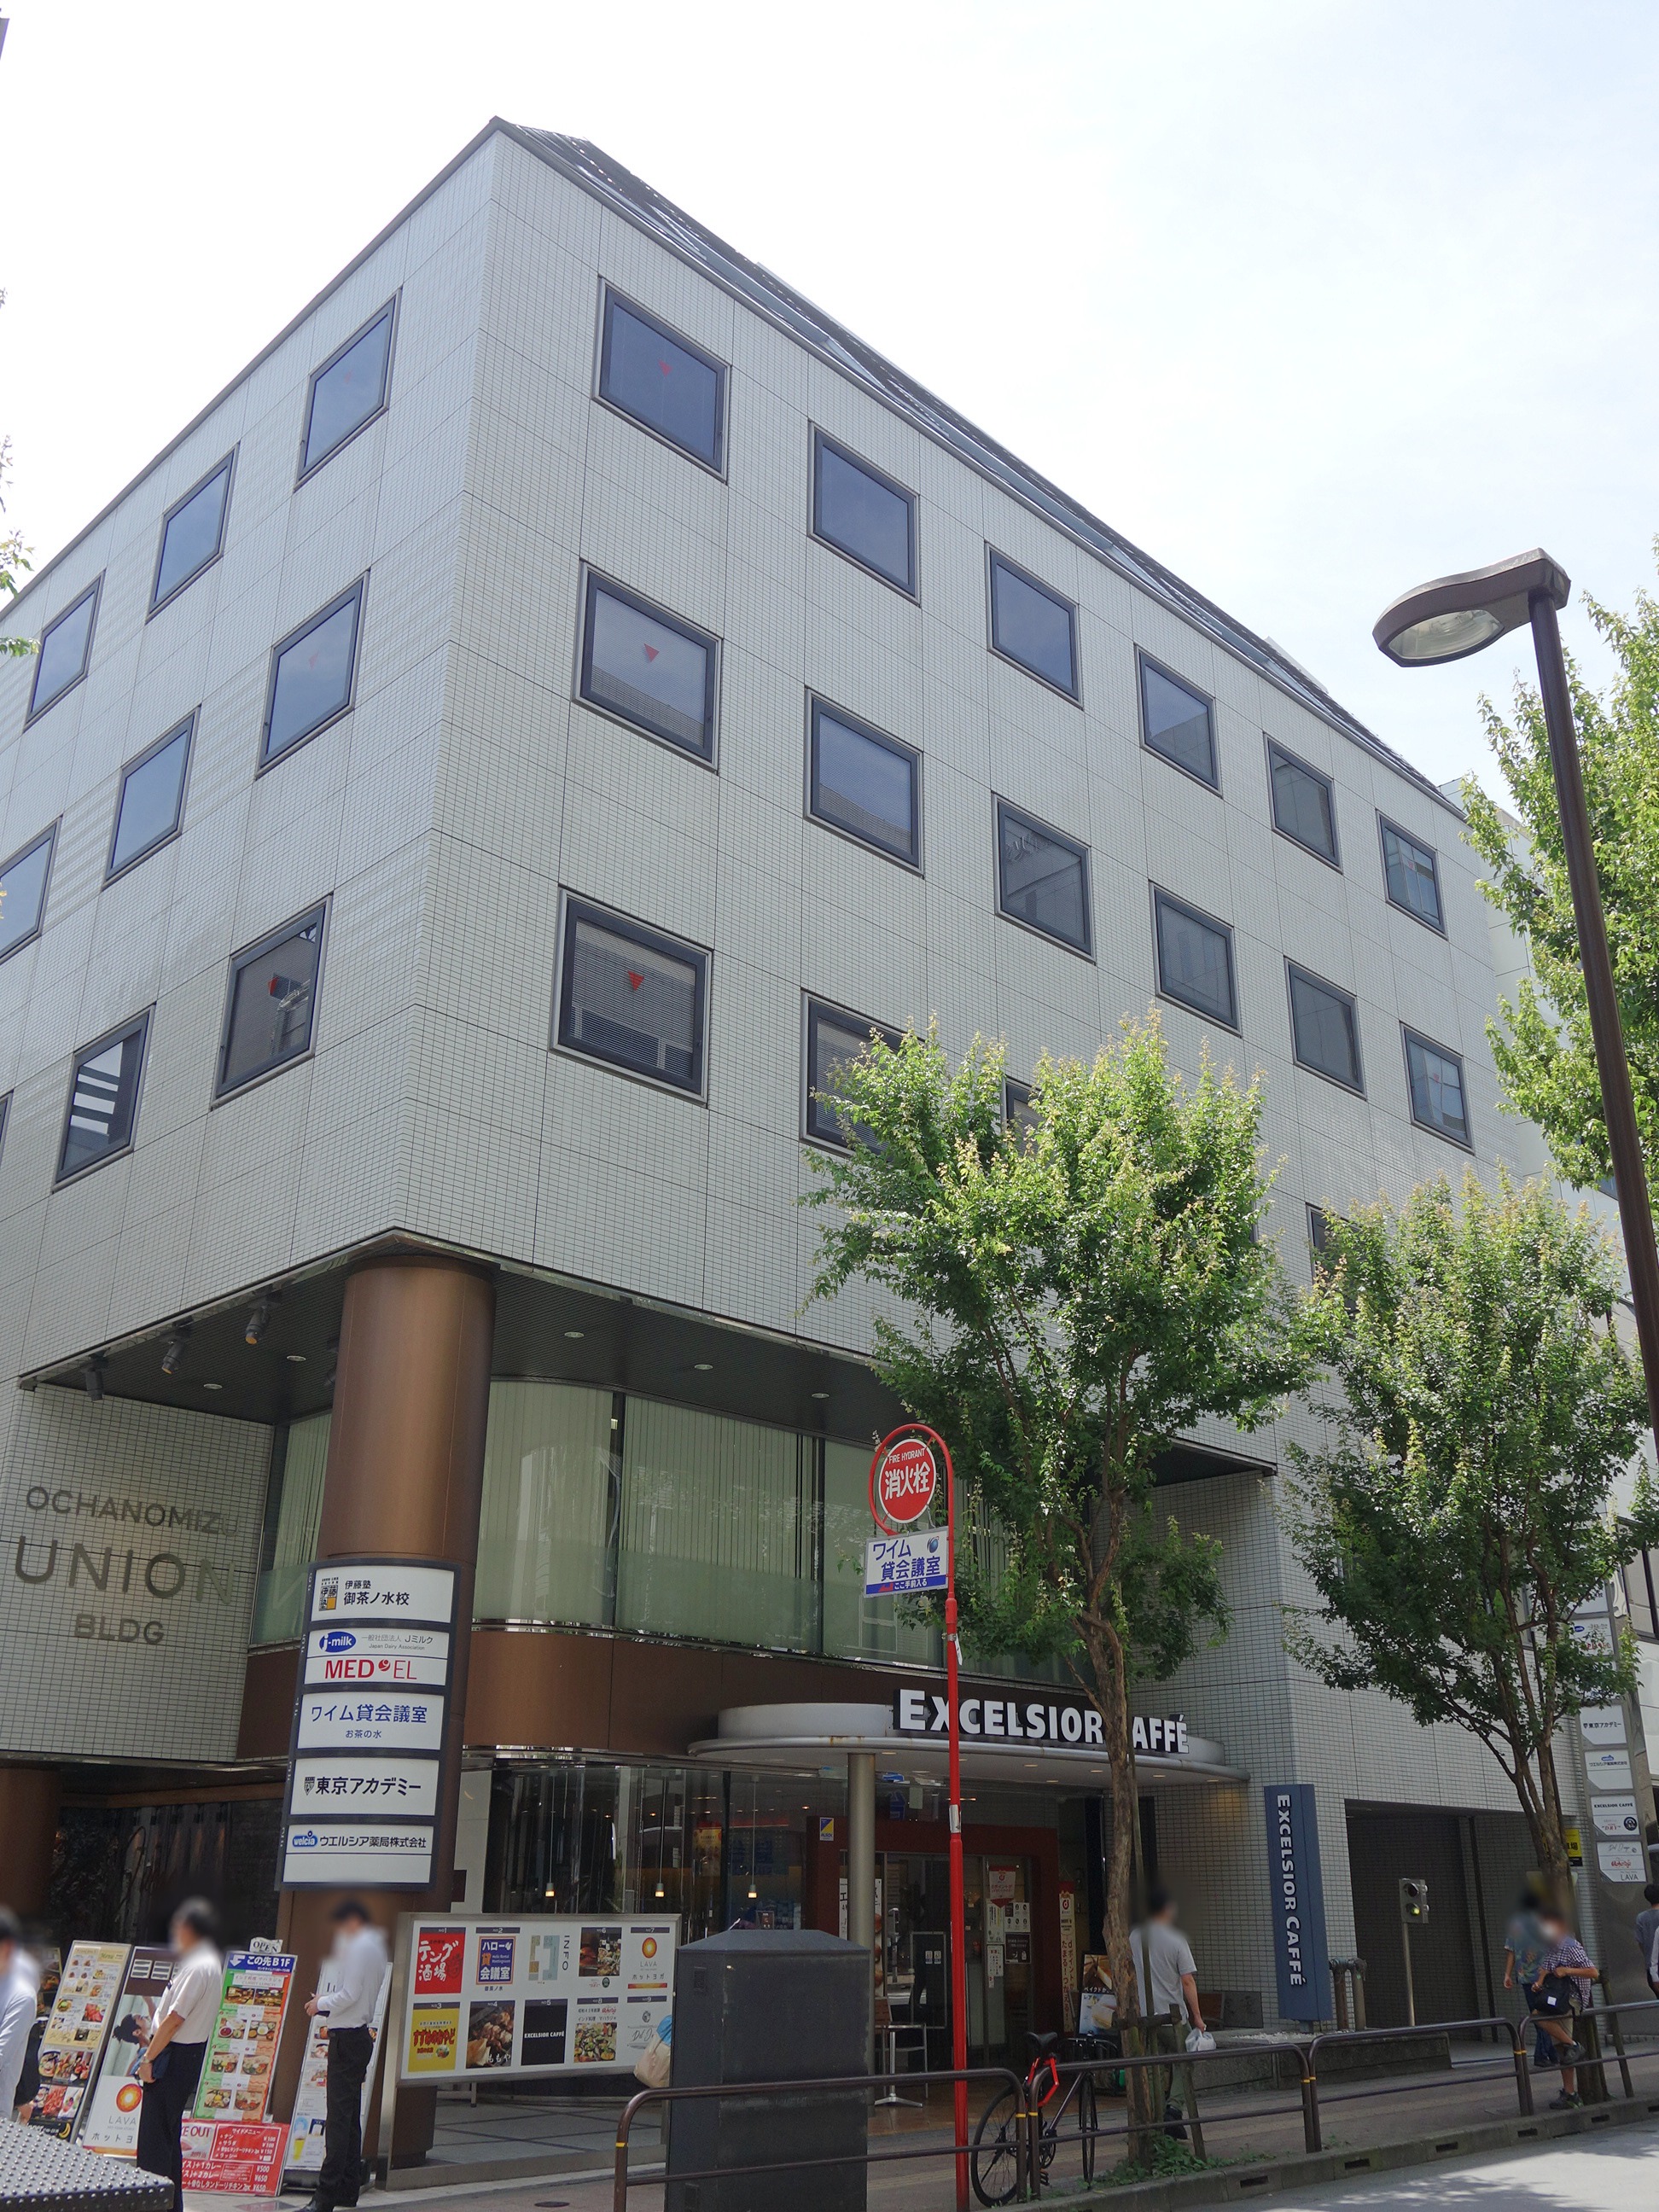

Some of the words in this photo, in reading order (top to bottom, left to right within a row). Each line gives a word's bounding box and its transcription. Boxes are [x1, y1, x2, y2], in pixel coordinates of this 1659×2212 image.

[888, 1453, 900, 1464] FIRE
[901, 1448, 926, 1462] HYDRANT
[884, 1461, 931, 1500] 消火栓
[26, 1486, 240, 1536] OCHANOMIZU
[872, 1539, 912, 1561] ワイム
[15, 1535, 235, 1605] UNION
[881, 1556, 940, 1582] 貸会議室
[345, 1580, 372, 1590] 伊藤塾
[894, 1578, 928, 1590] ここ手前入る
[343, 1592, 410, 1606] 御茶ノ水校
[74, 1613, 165, 1645] BLDG
[361, 1633, 402, 1642] 一般社団法人
[405, 1634, 434, 1644] Jミルク
[323, 1633, 352, 1652] j-milk
[324, 1659, 375, 1679] MED
[393, 1660, 417, 1679] EL
[311, 1704, 428, 1723] ワイム貸会議室
[899, 1689, 1104, 1744] EXCELSIOR
[1132, 1714, 1190, 1754] AFFÉ
[345, 1730, 382, 1738] お茶の水
[316, 1776, 422, 1796] 東京アカデミー
[293, 1831, 317, 1847] welcia
[319, 1836, 427, 1848] ウエルシア薬局株式会社
[1277, 1794, 1299, 1911] EXCELSIOR
[253, 1941, 278, 1953] OPEN
[418, 1940, 459, 1963] テング
[482, 1941, 505, 1951] ハロー
[562, 1935, 571, 1971] INFO
[1285, 1916, 1307, 1986] CAFFÉ
[418, 1962, 447, 1982] 酒場
[480, 1966, 510, 1981] 会議室
[108, 2116, 137, 2125] LAVA
[90, 2133, 134, 2144] ホットヨ
[190, 2126, 212, 2138] OUT
